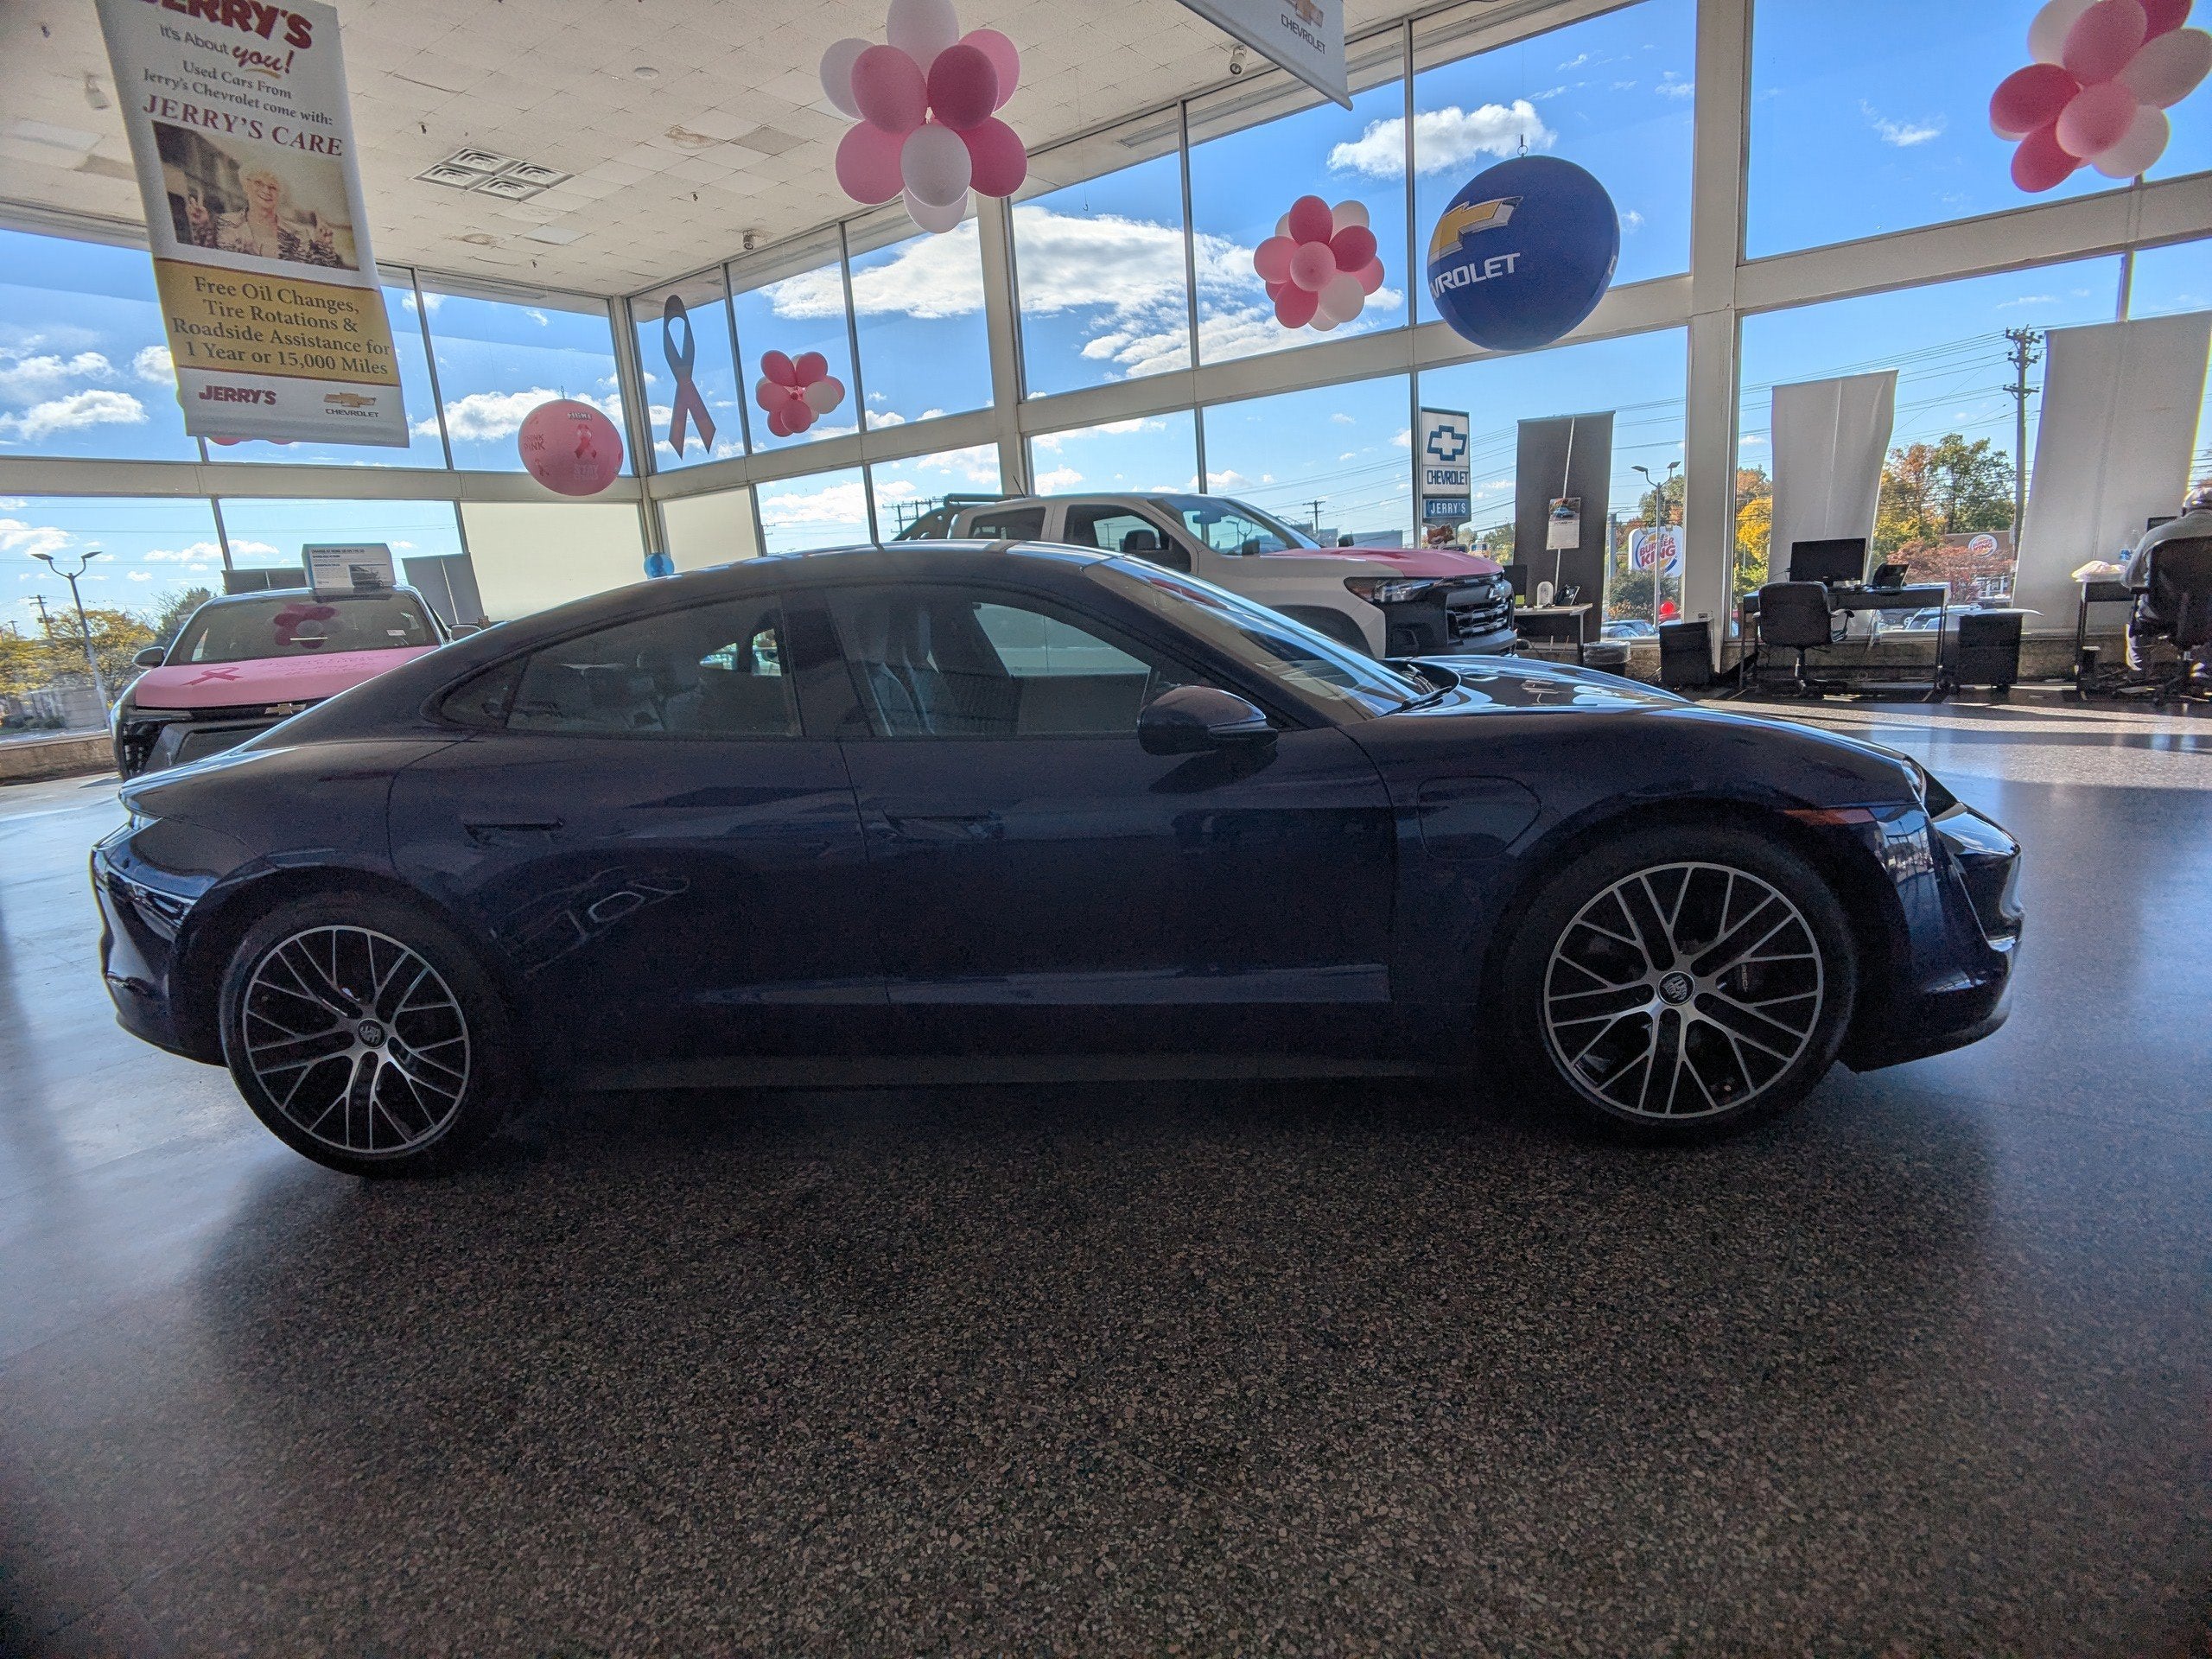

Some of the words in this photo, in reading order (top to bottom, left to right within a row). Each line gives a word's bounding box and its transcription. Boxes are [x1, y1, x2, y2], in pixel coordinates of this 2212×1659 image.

[159, 23, 181, 41] It's
[184, 30, 229, 55] About
[232, 45, 295, 74] you!
[1281, 13, 1326, 54] CHEVROLET
[143, 67, 188, 92] Jerry's
[192, 80, 260, 109] Chevrolet
[263, 100, 296, 118] come
[300, 110, 334, 126] with:
[181, 59, 217, 79] Used
[220, 70, 253, 90] Cars
[257, 79, 293, 99] From
[142, 92, 264, 140] JERRY'S
[271, 124, 343, 156] CARE
[194, 276, 237, 297] Free
[241, 283, 273, 302] Oil
[276, 287, 359, 315] Changes,
[202, 299, 245, 319] Tire
[250, 305, 339, 331] Rotations
[343, 316, 359, 334] &
[173, 316, 264, 342] Roadside
[270, 328, 362, 354] Assistance
[366, 339, 391, 356] for
[187, 340, 195, 358] 1
[202, 342, 245, 362] Year
[251, 351, 271, 365] or
[277, 351, 336, 371] 15,000
[340, 356, 388, 375] Miles
[198, 385, 277, 406] JERRY'S
[324, 408, 379, 418] CHEVROLET
[1427, 469, 1469, 486] CHEVROLET
[1430, 501, 1467, 515] JERRY'S
[1973, 543, 1993, 552] KING
